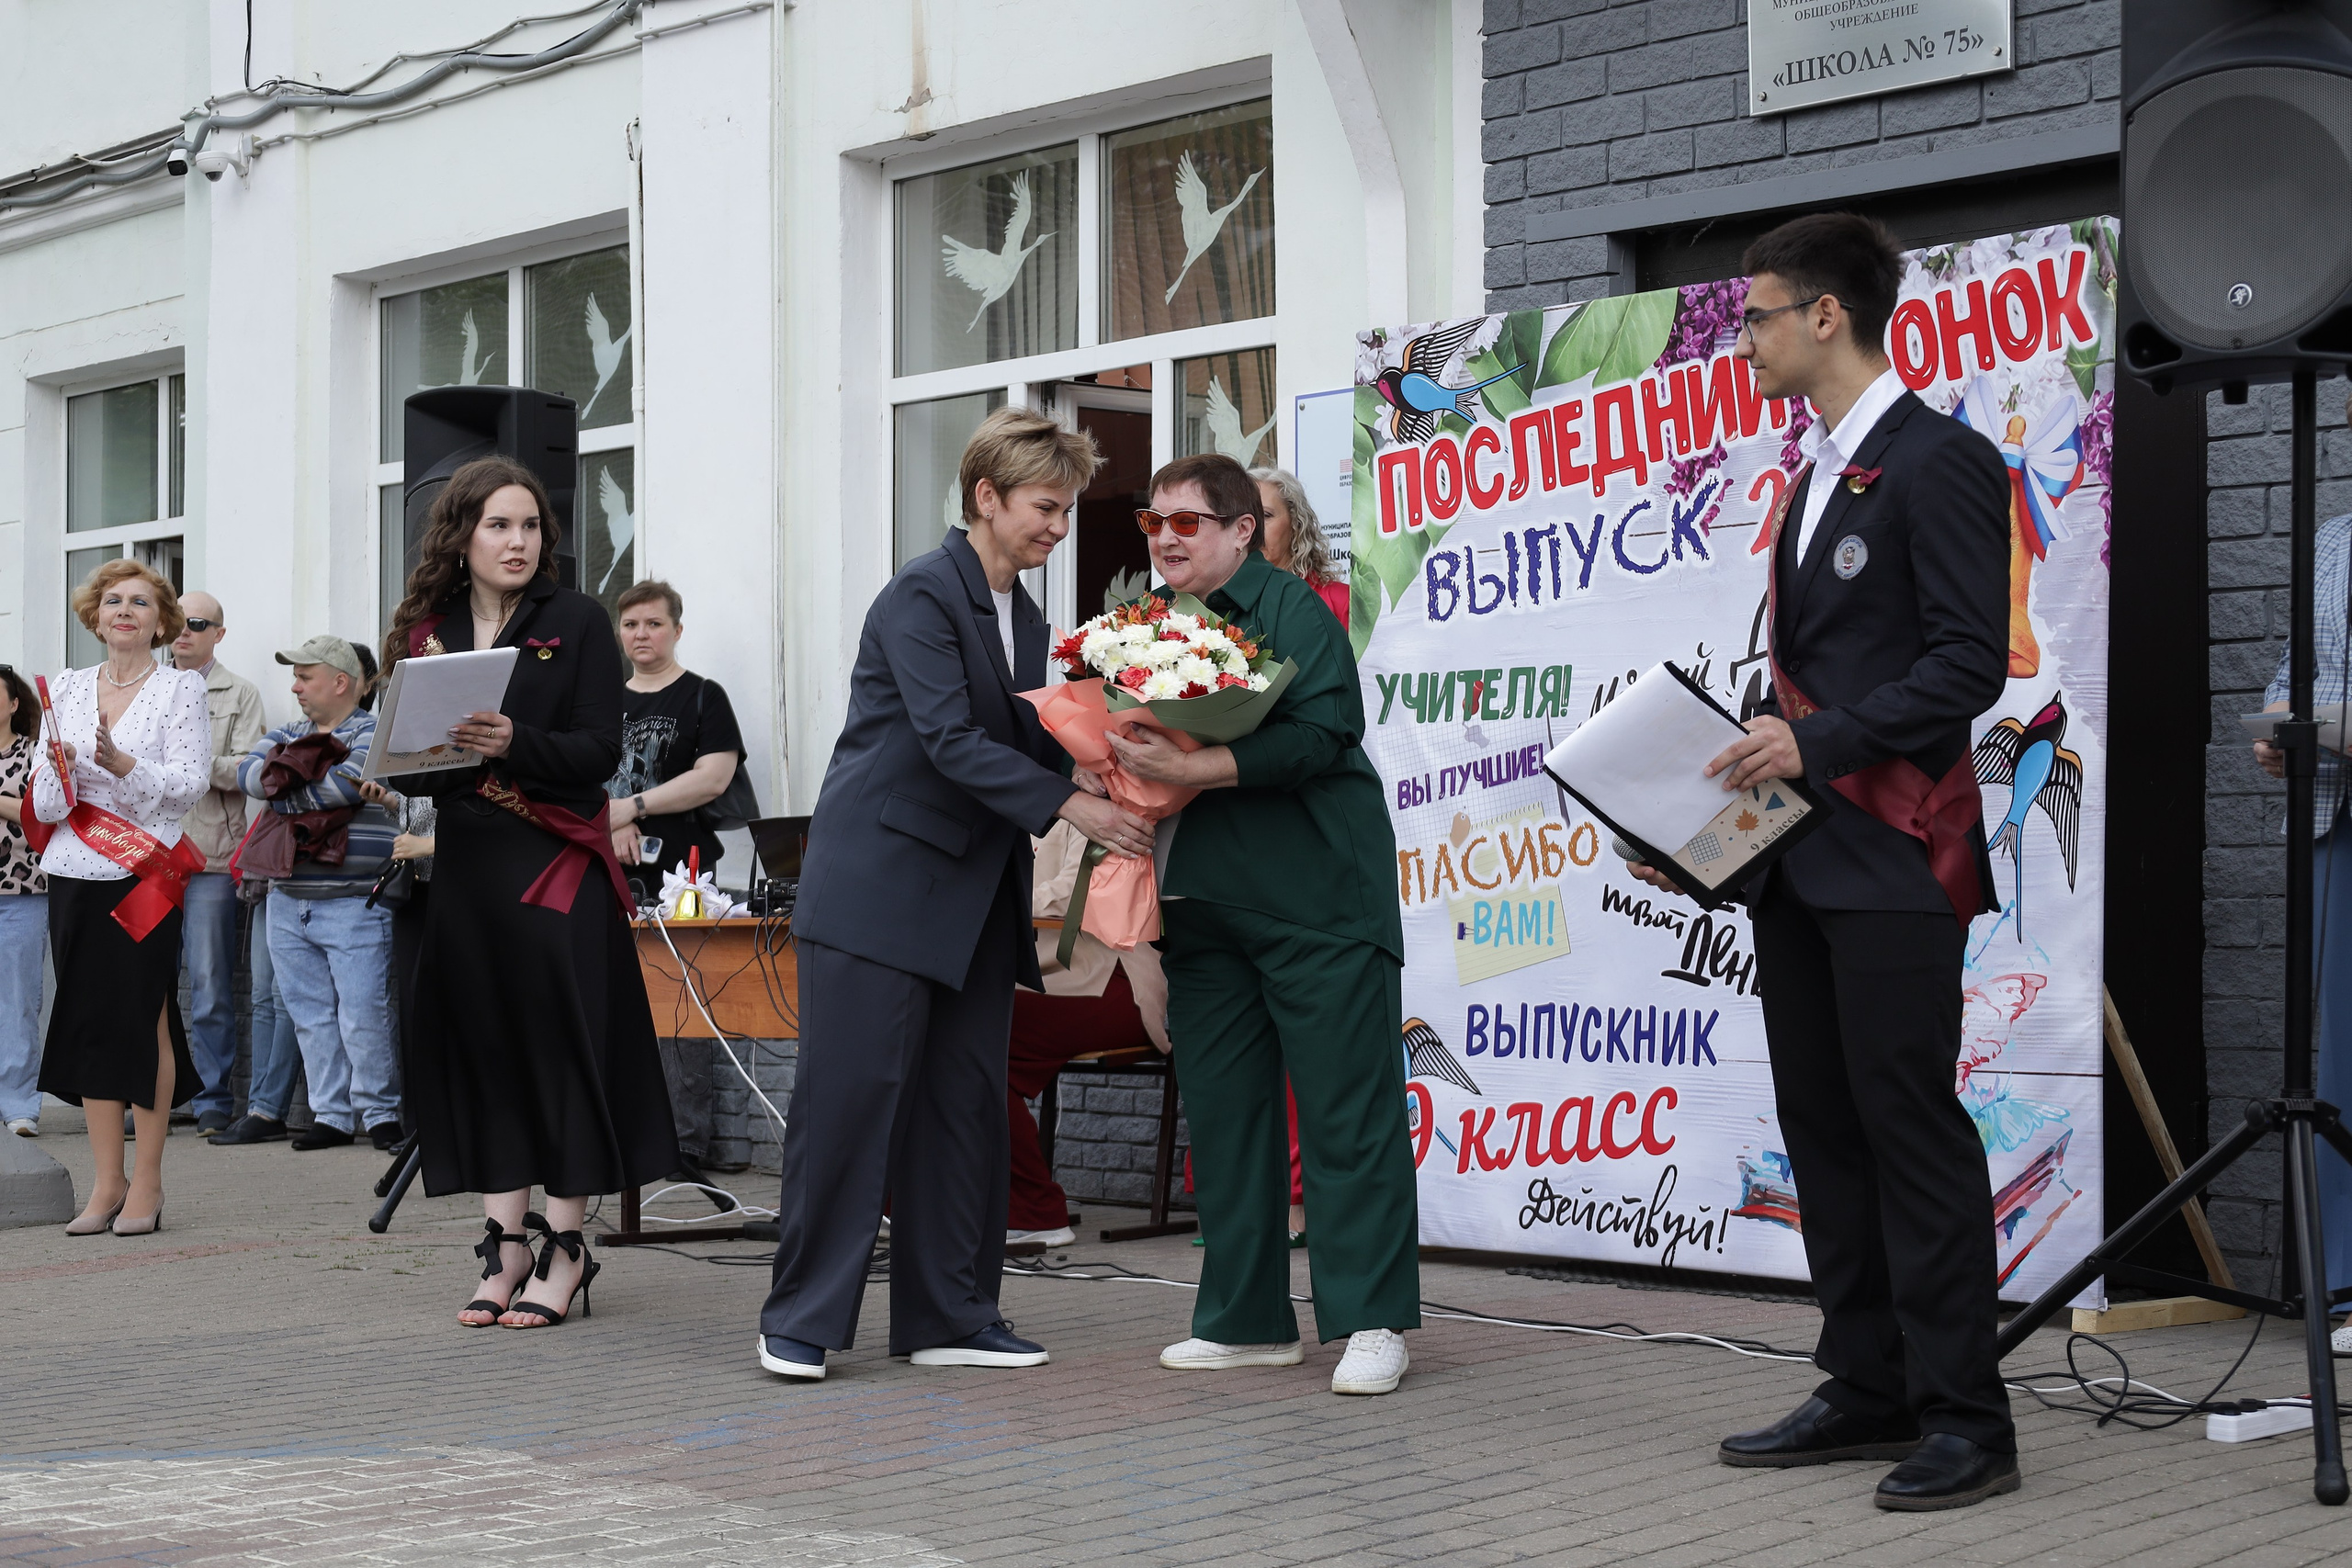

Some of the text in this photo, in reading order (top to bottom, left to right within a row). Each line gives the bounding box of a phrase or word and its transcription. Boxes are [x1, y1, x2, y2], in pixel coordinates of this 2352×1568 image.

[1794, 0, 1895, 22] ОБЩЕОБРАЗО
[1830, 3, 1919, 31] УЧРЕЖДЕНИЕ
[1772, 25, 1984, 87] «ШКОЛА № 75»
[1883, 250, 2094, 391] ОНОК
[1427, 474, 1719, 624] ВЫПУСК
[1374, 664, 1573, 725] УЧИТЕЛЯ!
[427, 757, 465, 768] классы
[1397, 742, 1544, 810] ВЫ ЛУЧШИЕ!
[1750, 807, 1805, 852] 9 классы
[1397, 820, 1600, 907] ПАСИБО
[1473, 899, 1555, 948] ВАМ!
[1465, 1001, 1720, 1066] ВЫПУСКНИК
[1456, 1086, 1679, 1175] класс
[1519, 1164, 1730, 1268] Действуй!
